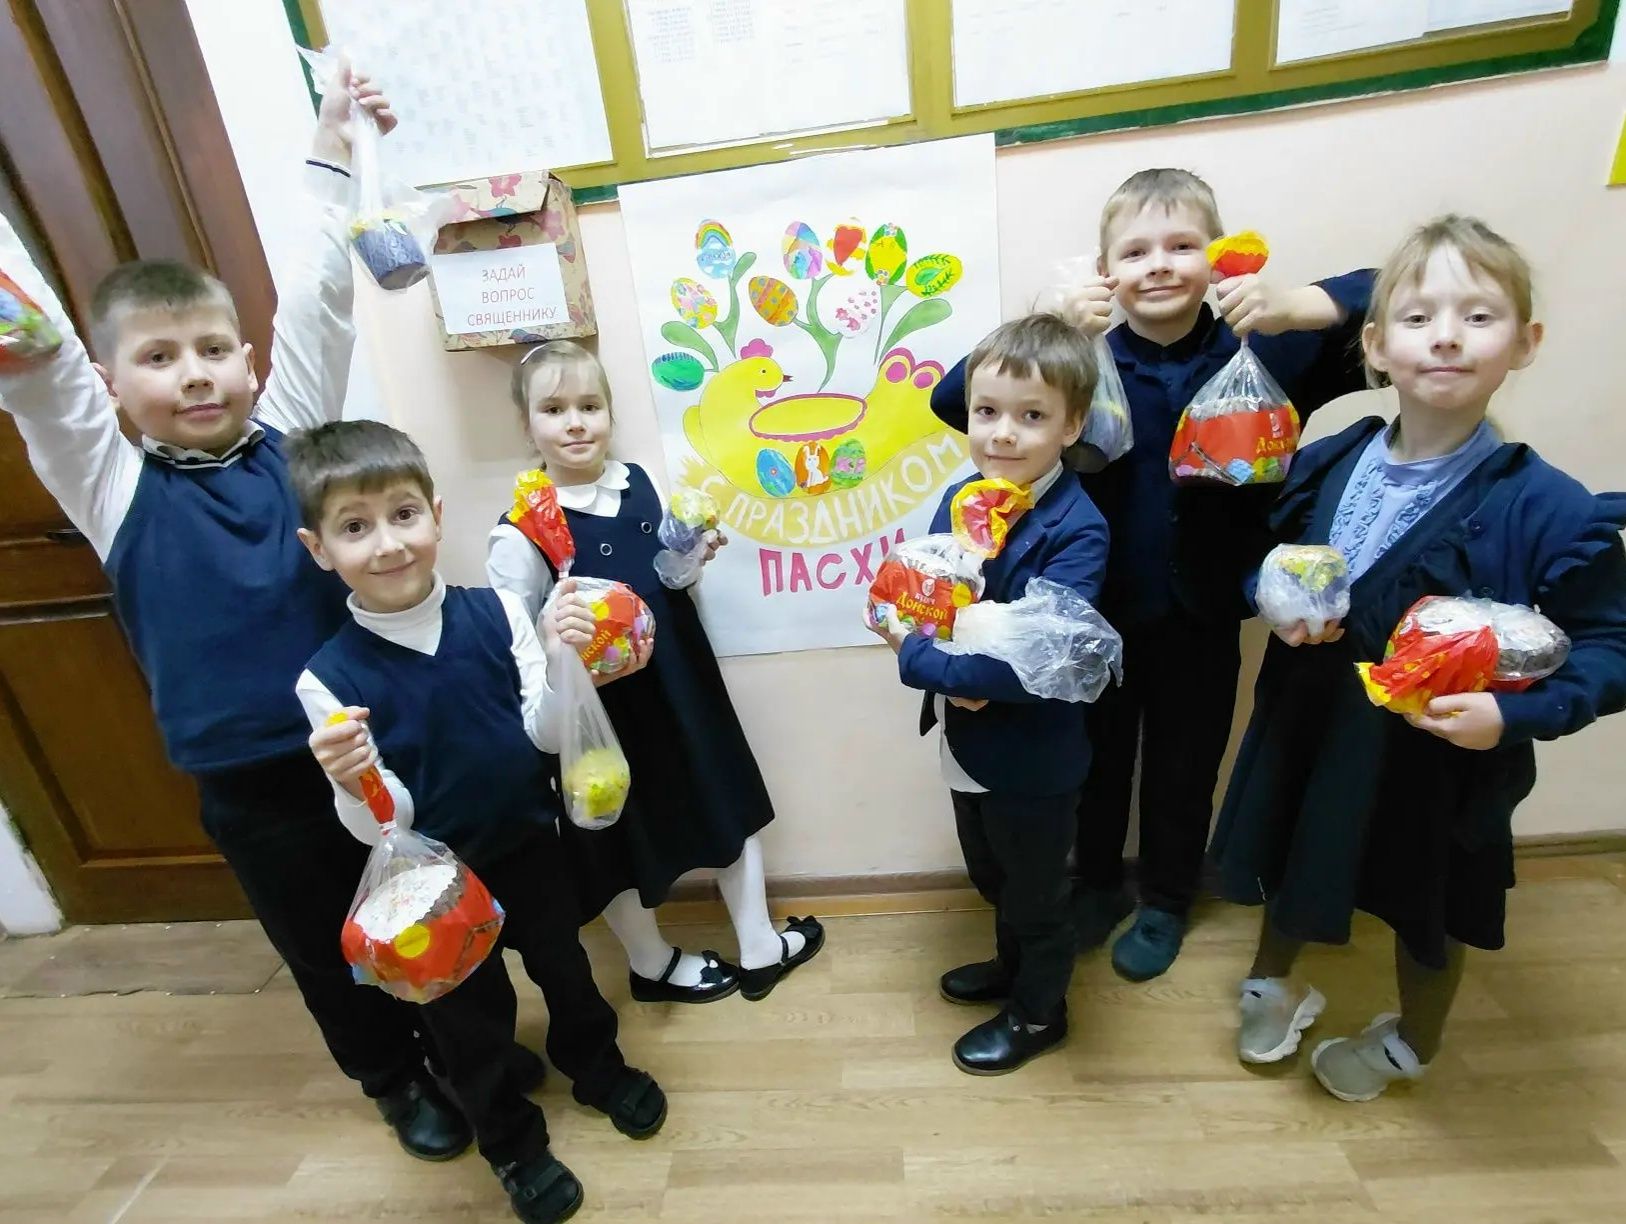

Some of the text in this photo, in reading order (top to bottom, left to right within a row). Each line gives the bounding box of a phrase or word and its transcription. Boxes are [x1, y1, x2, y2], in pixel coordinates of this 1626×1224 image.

[482, 264, 527, 283] ЗАДАЙ
[481, 287, 535, 303] ВОПРОС
[467, 307, 556, 327] СВЯЩЕННИКУ
[725, 434, 963, 544] ПРАЗДНИКОМ
